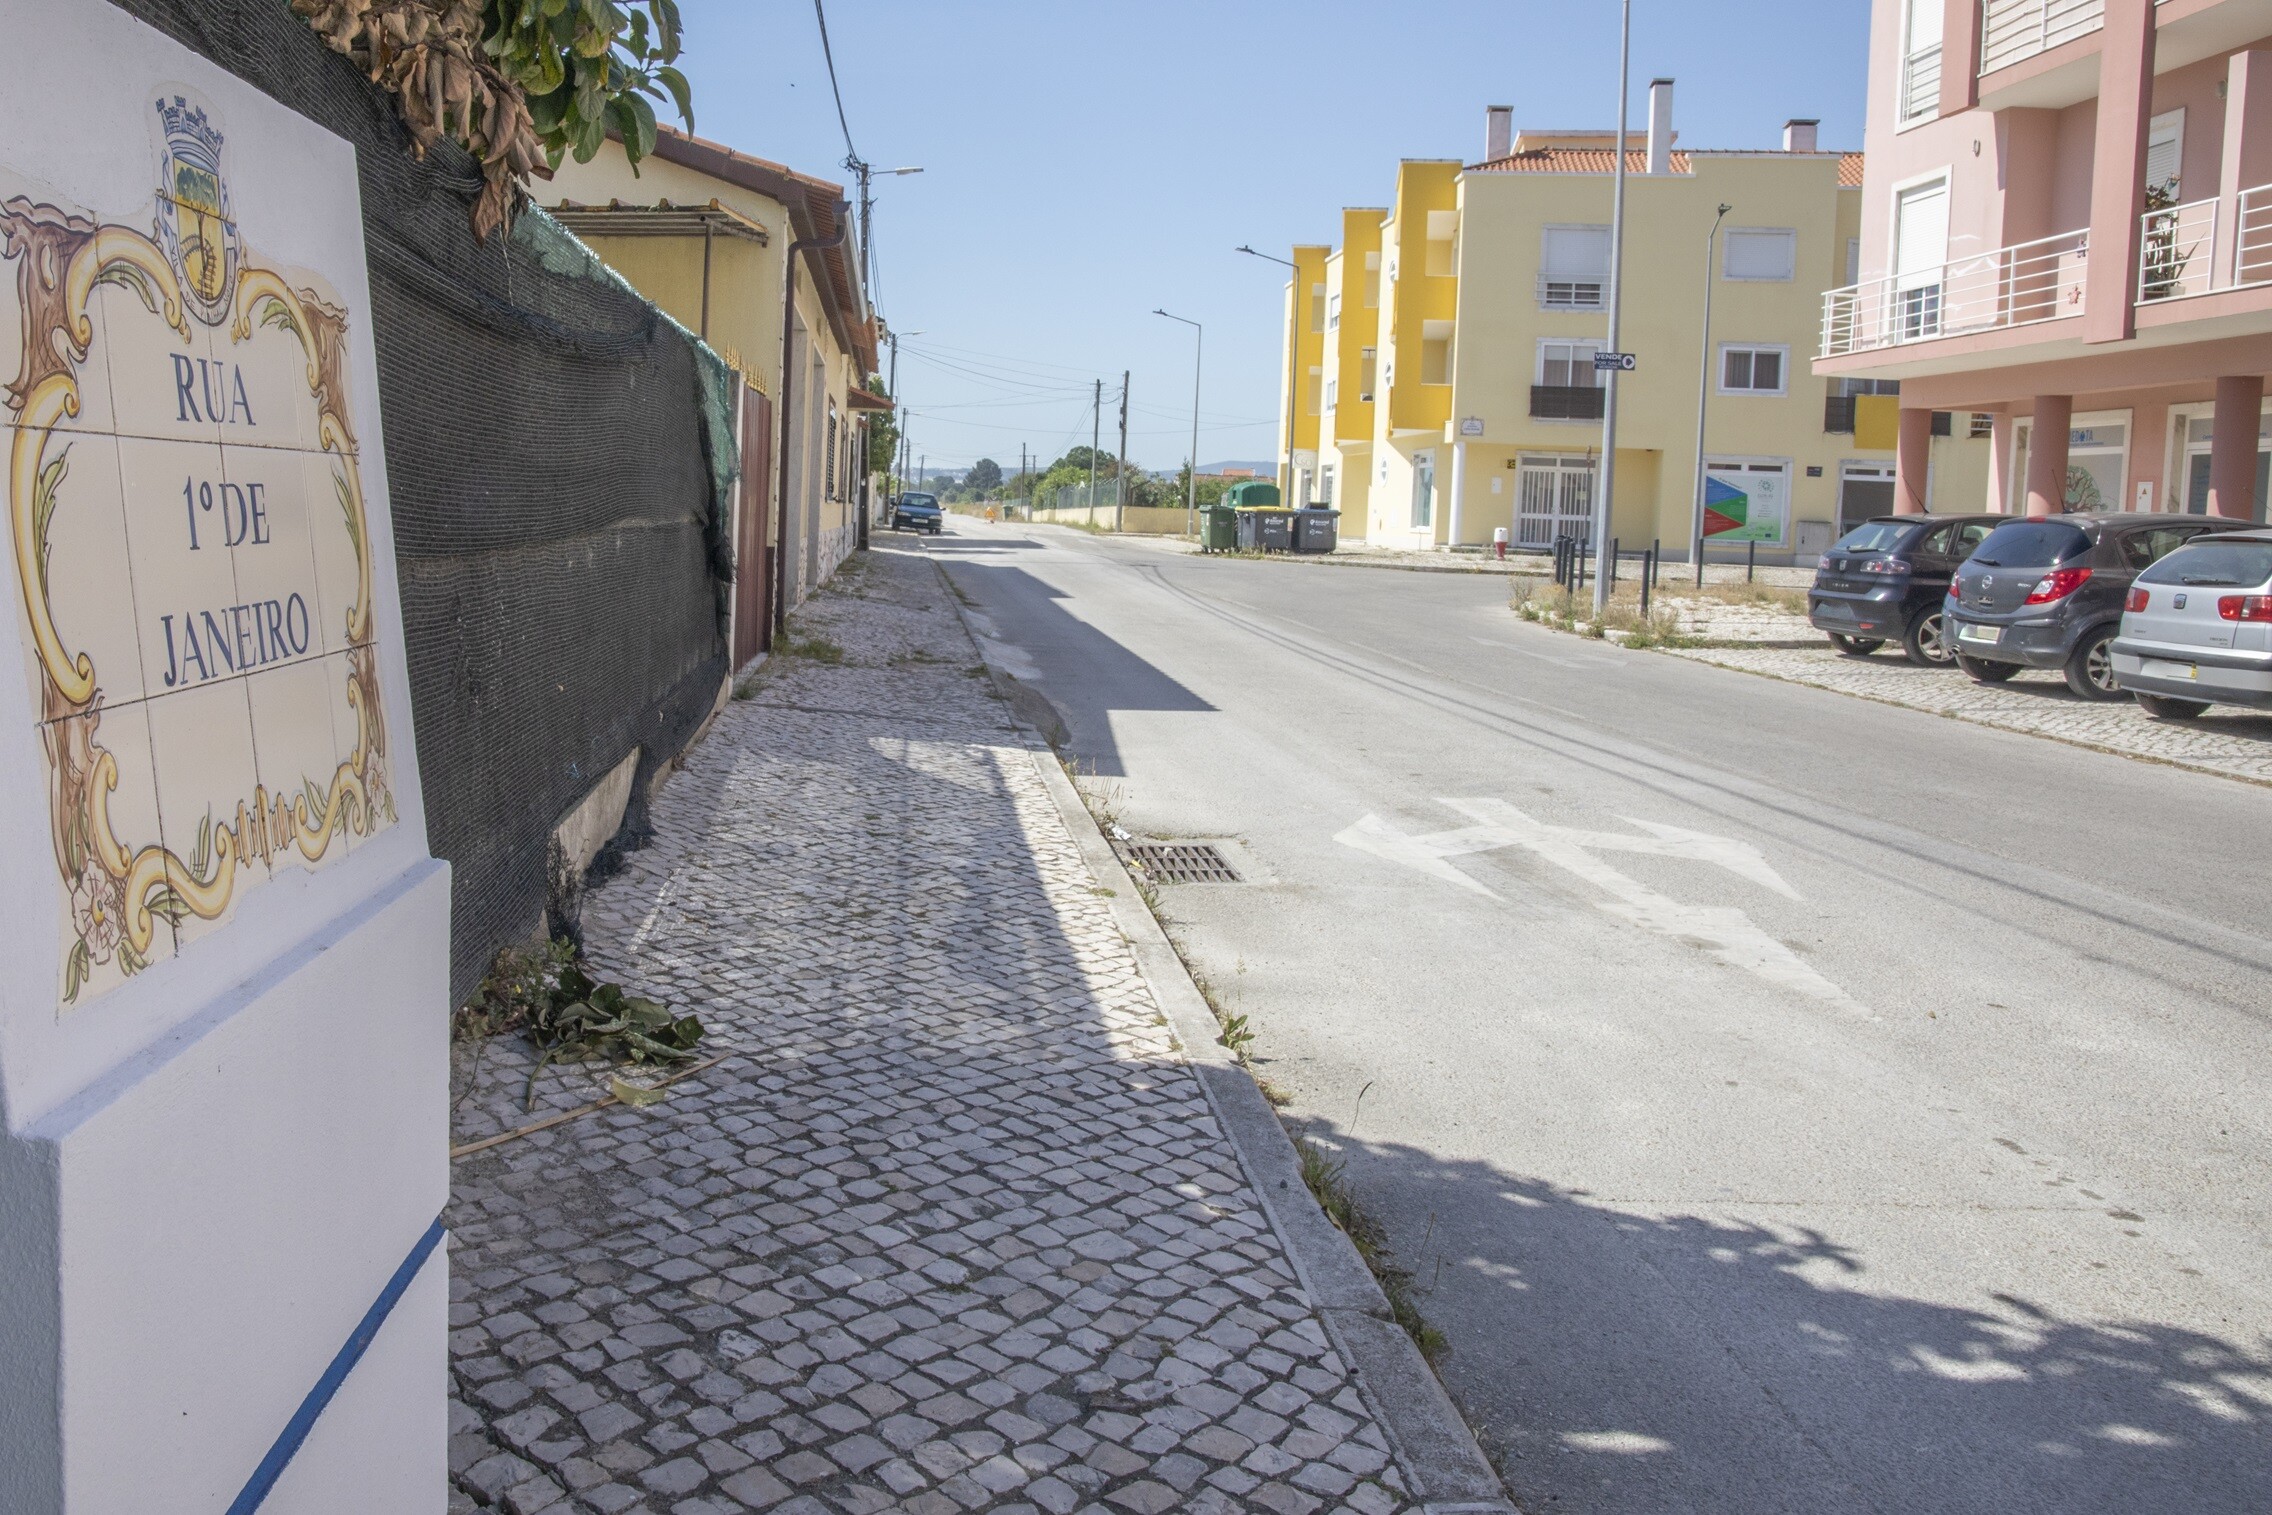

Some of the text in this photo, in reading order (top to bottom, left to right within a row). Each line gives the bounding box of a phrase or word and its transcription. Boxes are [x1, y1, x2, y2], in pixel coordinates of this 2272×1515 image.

[169, 353, 256, 426] RUA
[219, 483, 270, 547] DE
[160, 592, 309, 687] JANEIRO
